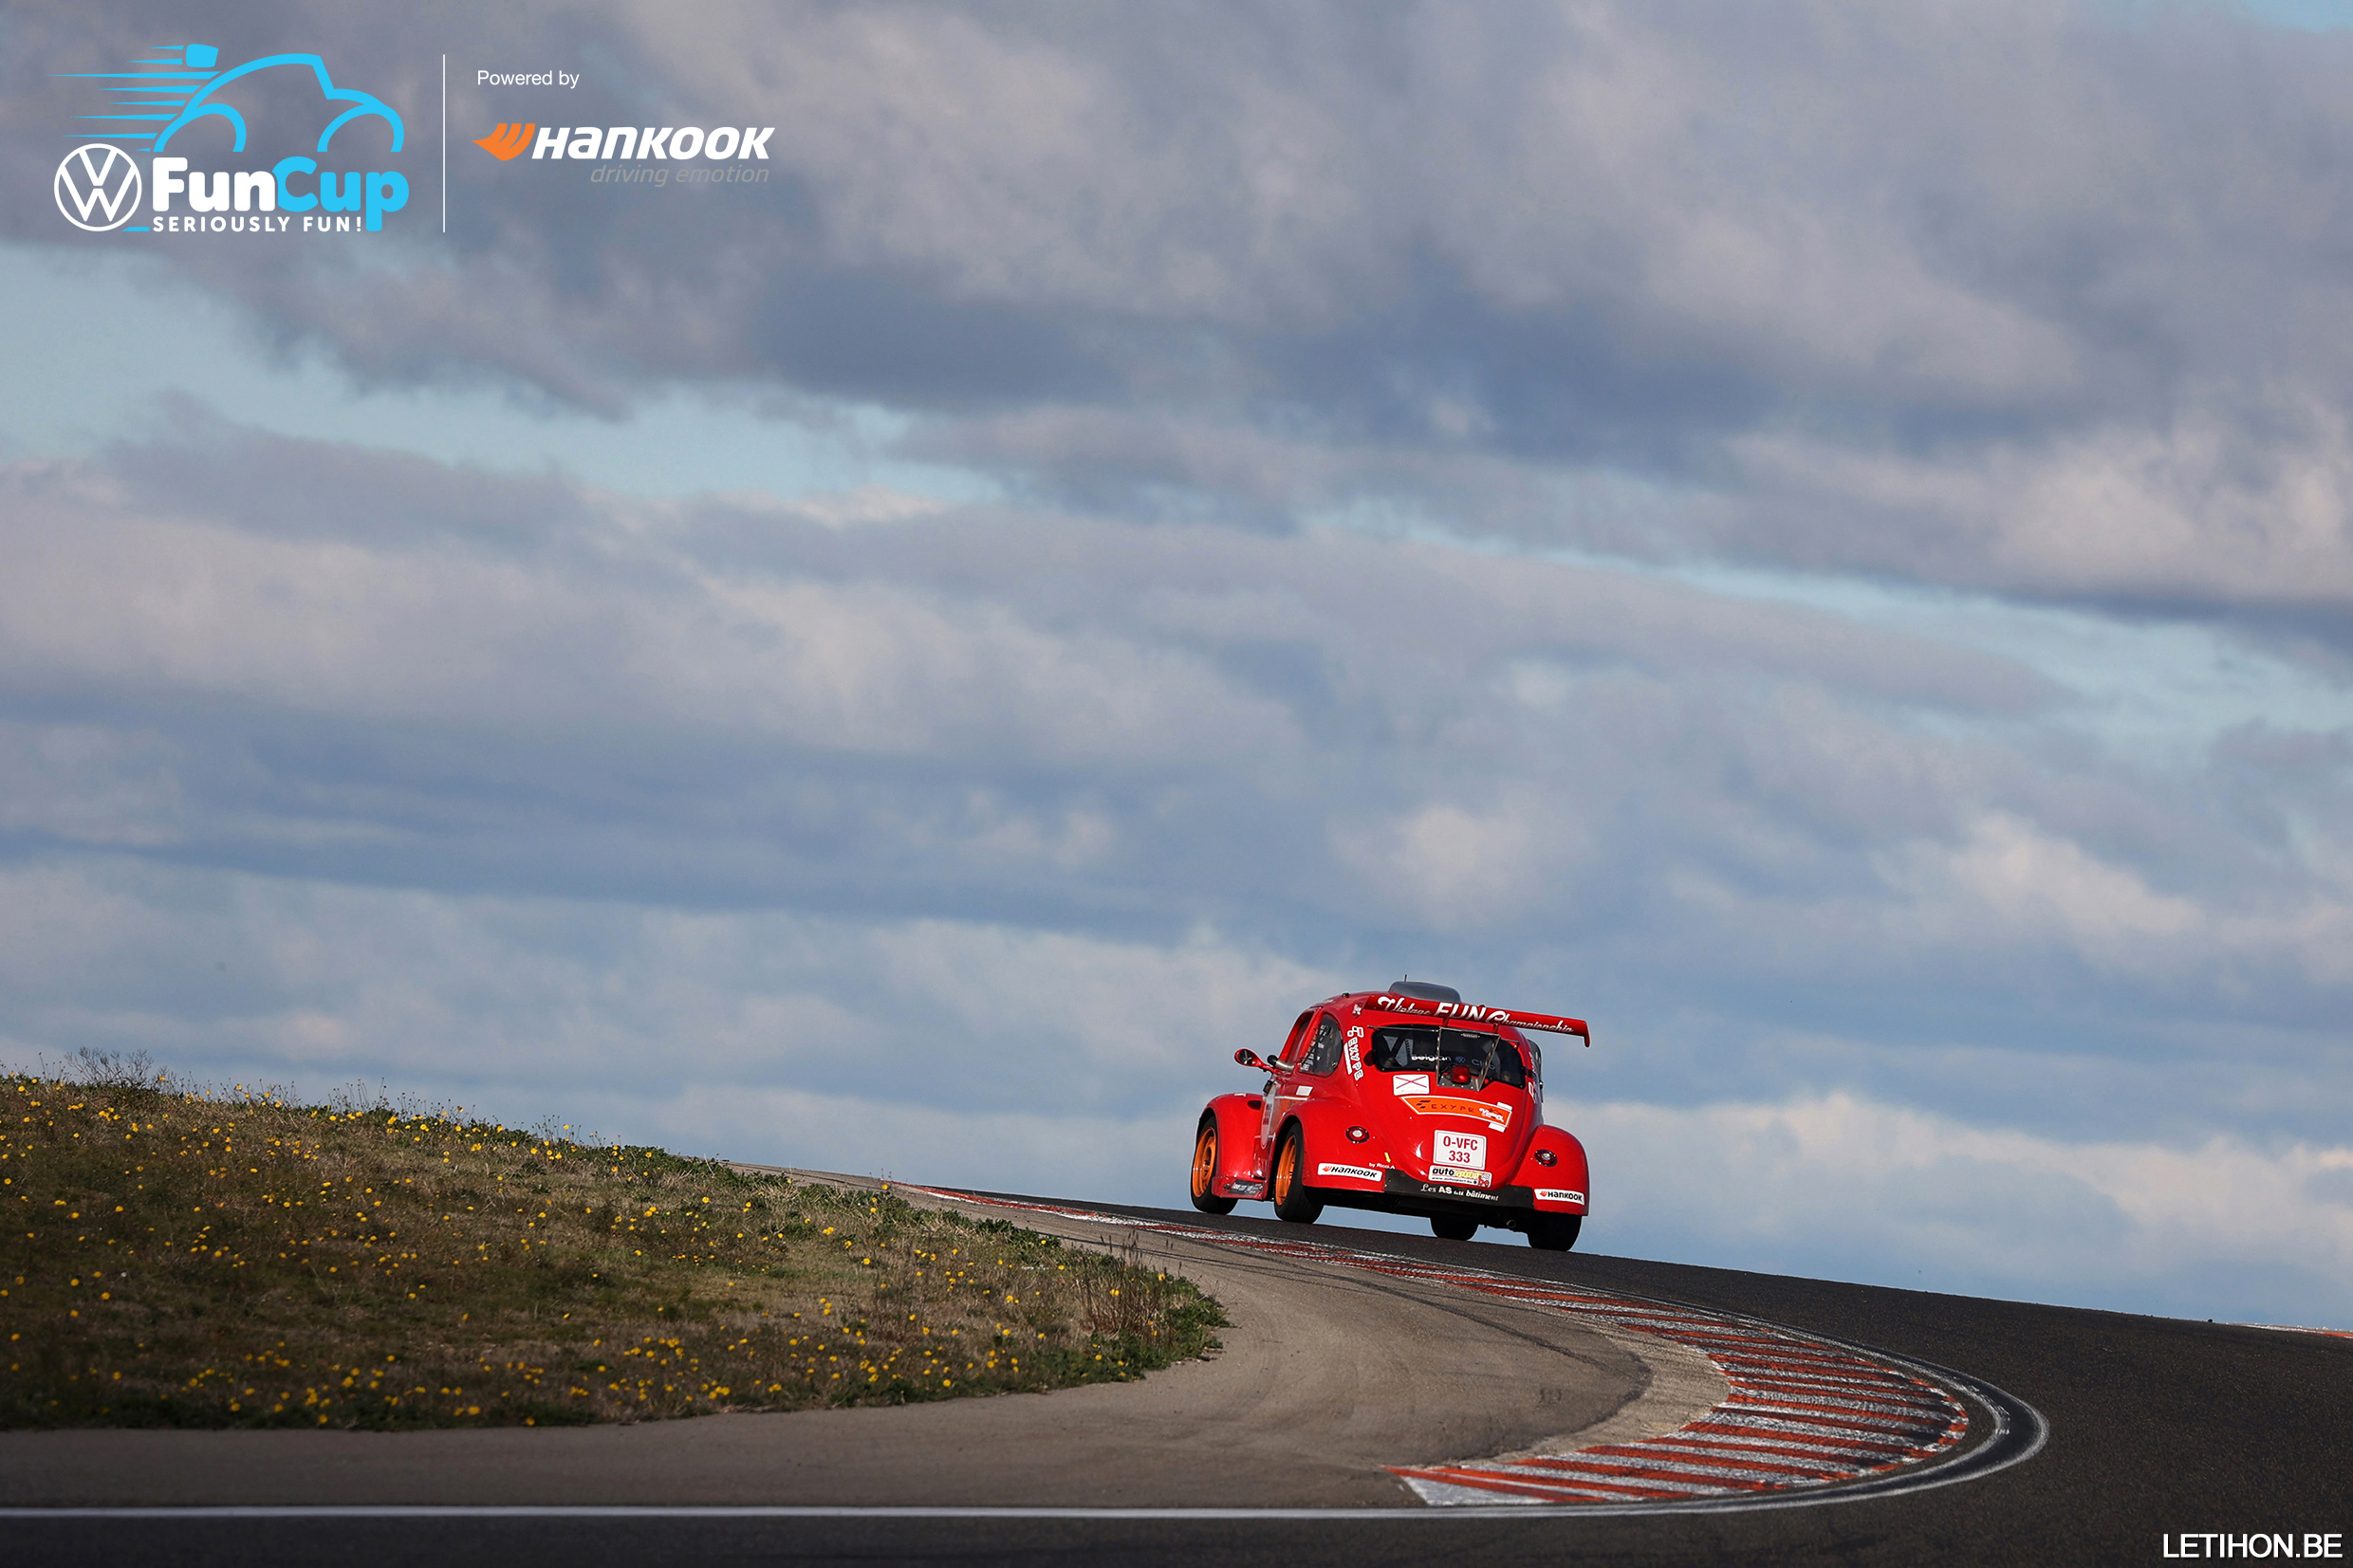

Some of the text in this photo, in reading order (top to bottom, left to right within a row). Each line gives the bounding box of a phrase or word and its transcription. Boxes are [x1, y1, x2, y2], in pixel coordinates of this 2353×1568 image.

[1434, 1002, 1487, 1022] FUN
[1348, 1037, 1363, 1081] EXYPE
[1448, 1150, 1471, 1163] 333
[1420, 1183, 1436, 1193] Les
[1438, 1186, 1453, 1194] AS
